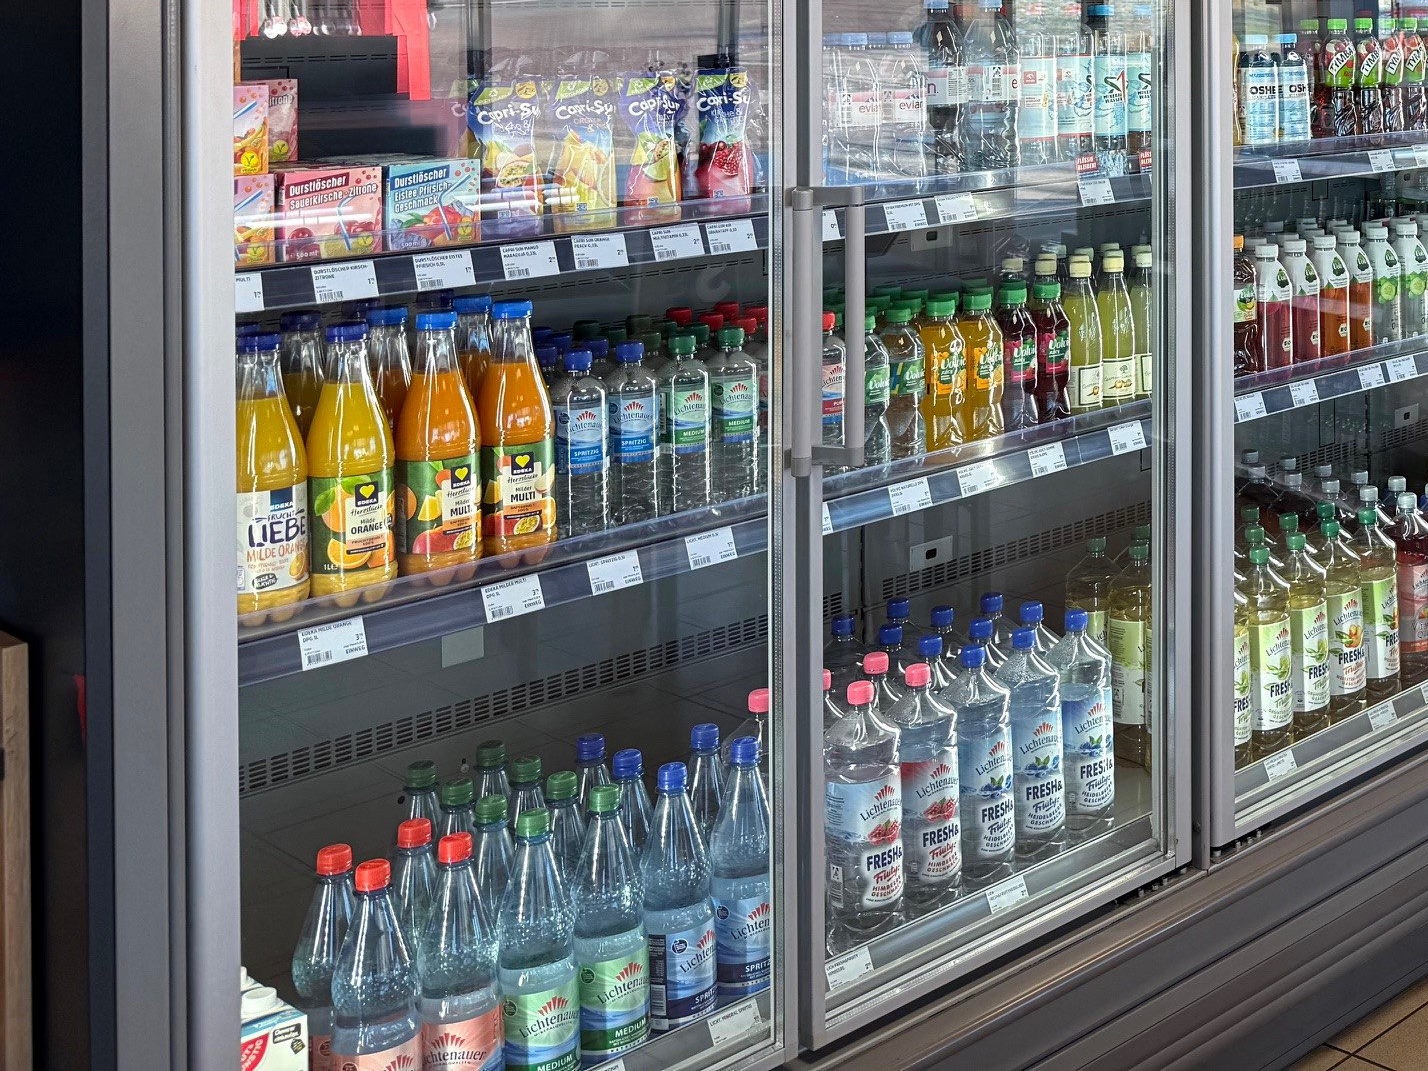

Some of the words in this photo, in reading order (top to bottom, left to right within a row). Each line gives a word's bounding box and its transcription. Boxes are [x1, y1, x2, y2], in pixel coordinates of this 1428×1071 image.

[1250, 85, 1282, 95] OSHEE
[395, 168, 447, 188] Durstlöscher
[290, 175, 346, 197] Durstlöscher
[395, 187, 418, 201] Eistee
[395, 195, 438, 213] Geschmack
[415, 255, 449, 263] DURSTLÖSCHER
[314, 267, 349, 275] DURSTLÖSCHER
[683, 429, 705, 437] MEDIUM
[622, 438, 646, 446] SPRITZIG
[574, 449, 599, 457] SPRITZIG
[453, 480, 470, 488] EDEKA
[357, 498, 377, 506] EDEKA
[511, 491, 535, 503] MULTI
[270, 502, 293, 510] EDEKA
[268, 512, 295, 521] FRUCHT
[248, 516, 306, 548] LIEBE
[351, 523, 383, 535] ORANGE
[247, 548, 276, 562] MILDE
[485, 585, 499, 593] EDEKA
[524, 600, 542, 608] EINWEG
[302, 628, 317, 637] EDEKA
[318, 625, 332, 634] MILDE
[346, 645, 366, 654] EINWEG
[1338, 646, 1365, 665] FRESH&
[1026, 779, 1062, 801] FRESH&
[981, 799, 1013, 823] FRESH&
[923, 823, 959, 848] FRESH&
[867, 844, 902, 872] FRESH&
[615, 1018, 646, 1038] MEDIUM
[537, 1054, 573, 1071] MEDIUM
